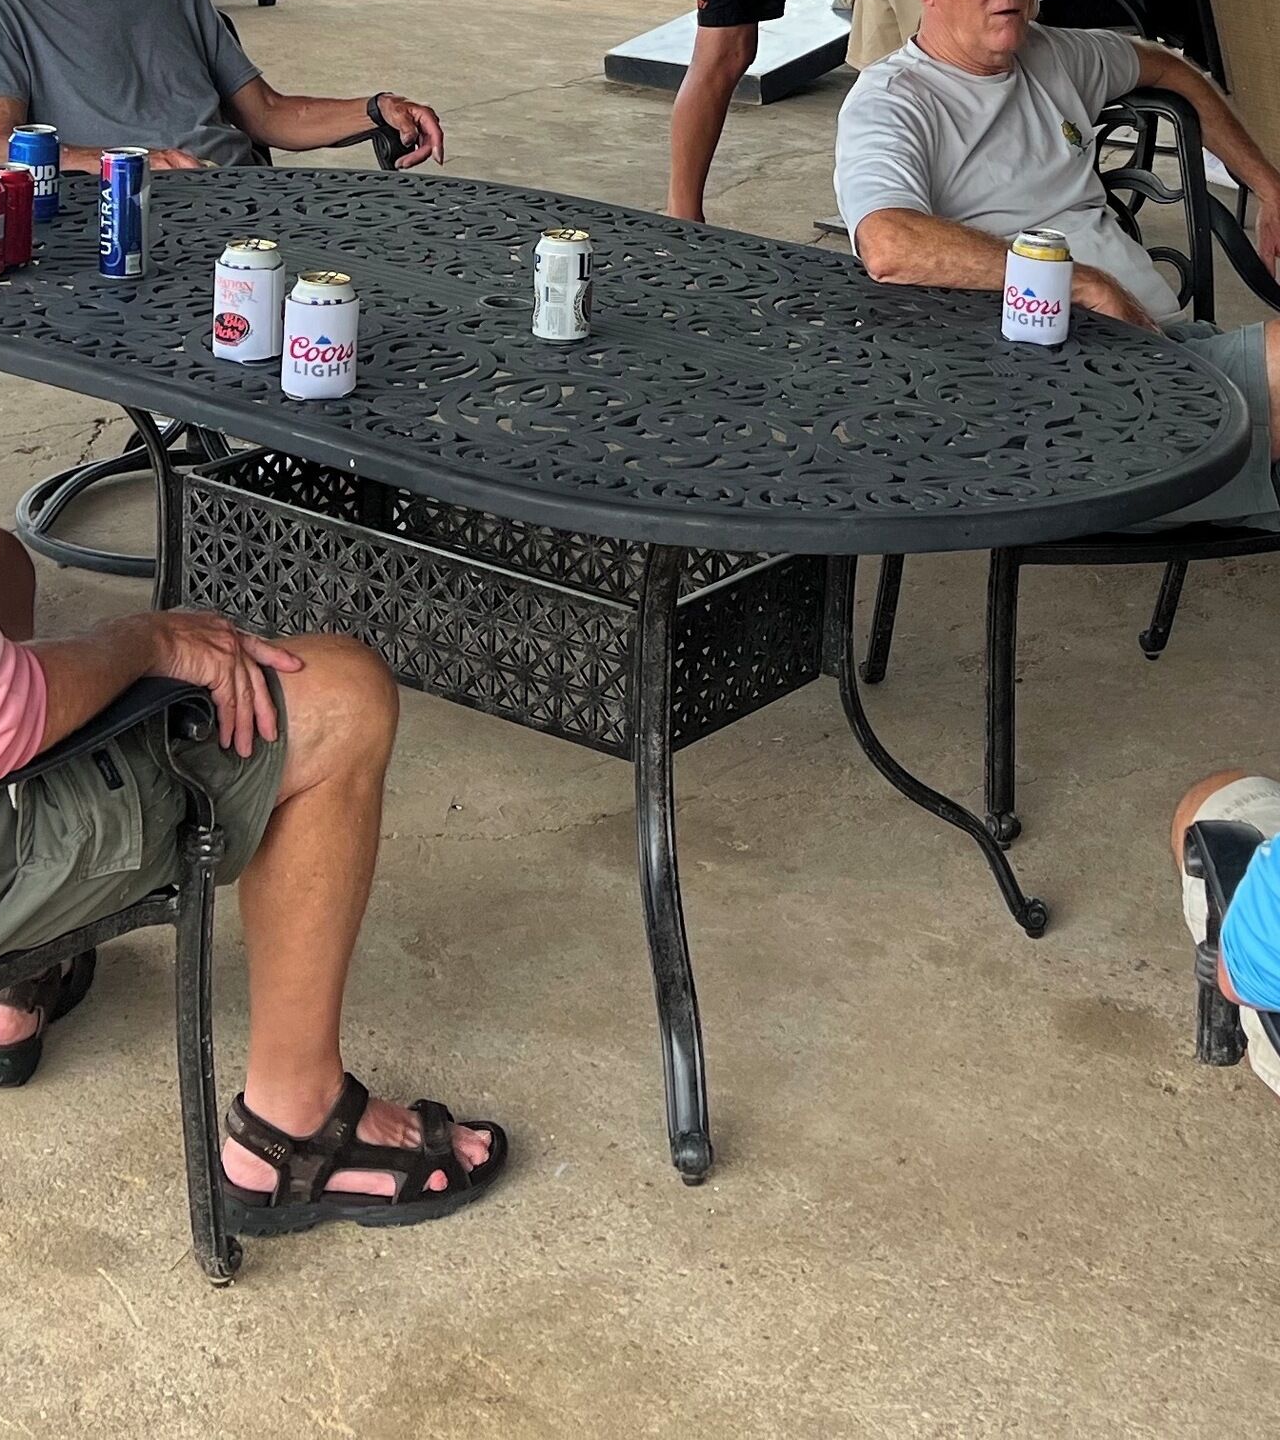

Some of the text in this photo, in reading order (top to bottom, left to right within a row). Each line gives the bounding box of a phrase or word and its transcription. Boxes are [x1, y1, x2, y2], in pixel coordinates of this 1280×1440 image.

[100, 188, 113, 256] ULTRA
[1006, 286, 1062, 315] Coors
[1006, 308, 1056, 328] LIGHT
[289, 335, 356, 363] Coors
[293, 361, 350, 378] LIGHT
